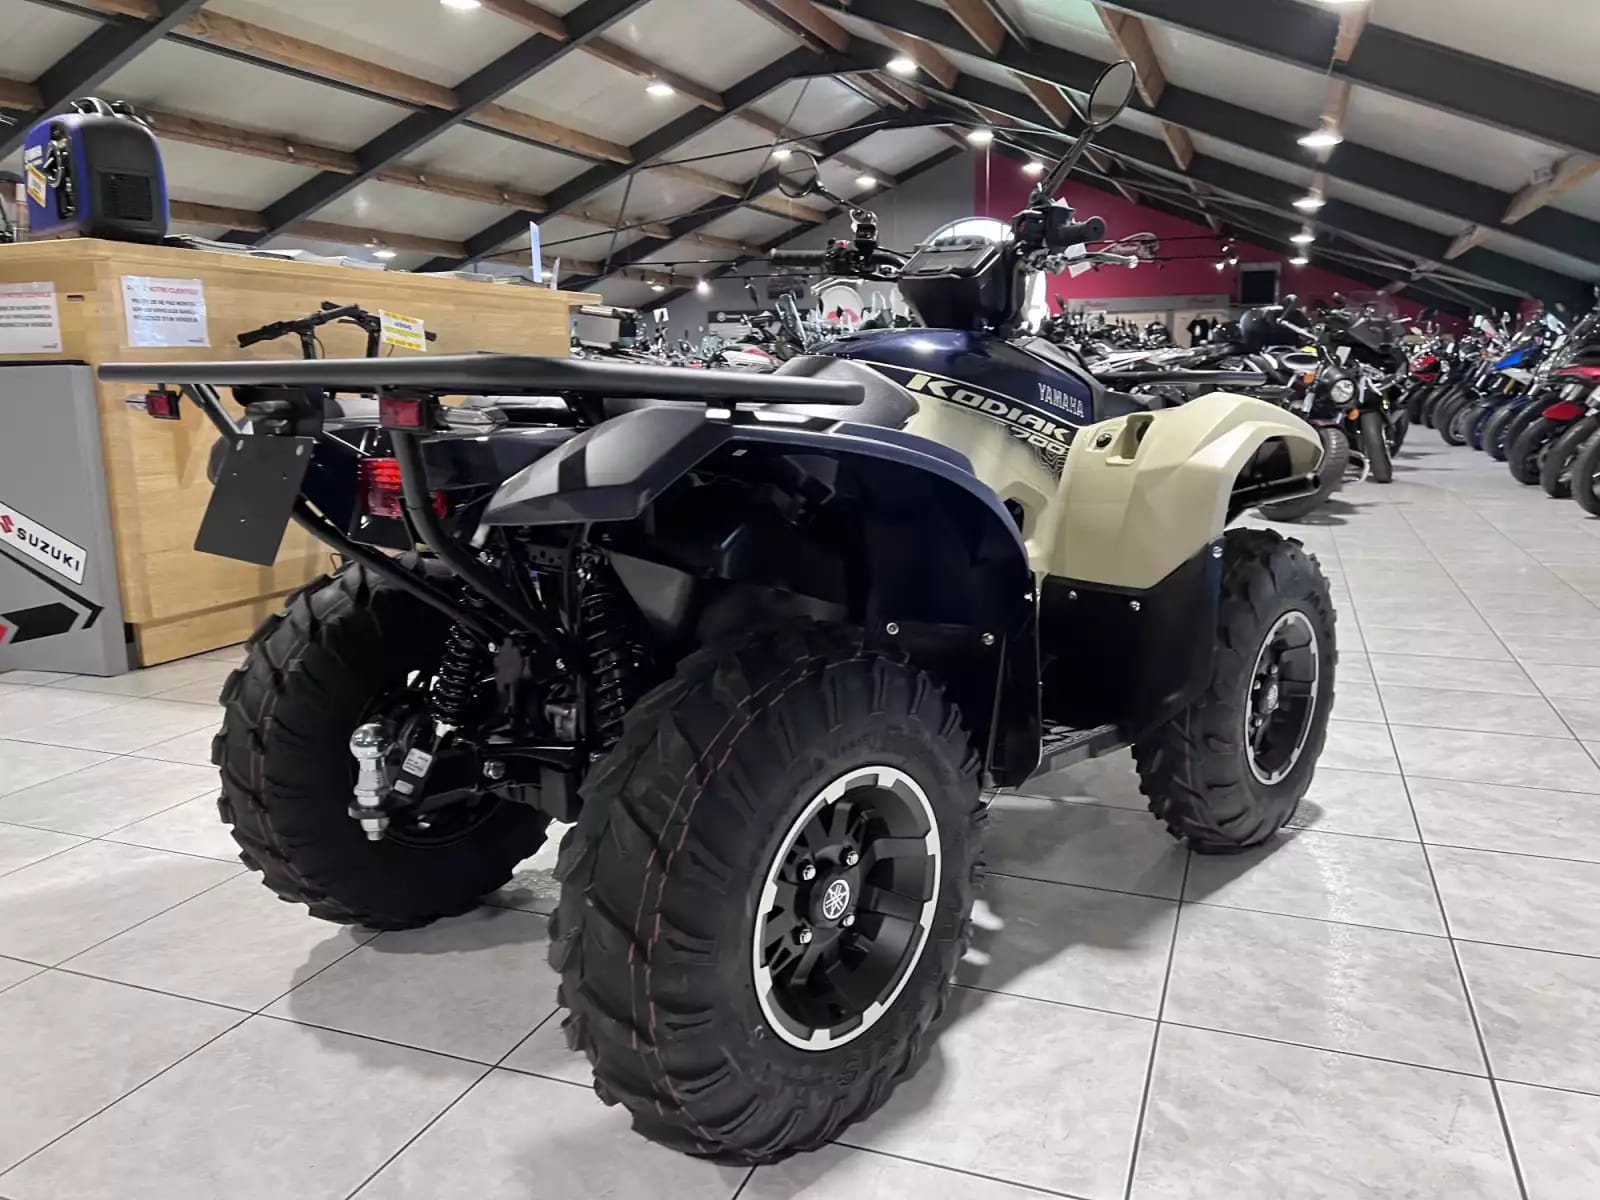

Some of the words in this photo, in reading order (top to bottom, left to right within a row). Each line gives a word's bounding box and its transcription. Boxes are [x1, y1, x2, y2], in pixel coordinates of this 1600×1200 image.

[905, 373, 1071, 442] KODIAK
[1038, 382, 1085, 418] YAMAHA
[1010, 425, 1066, 455] 700
[17, 527, 80, 572] SUZUKI
